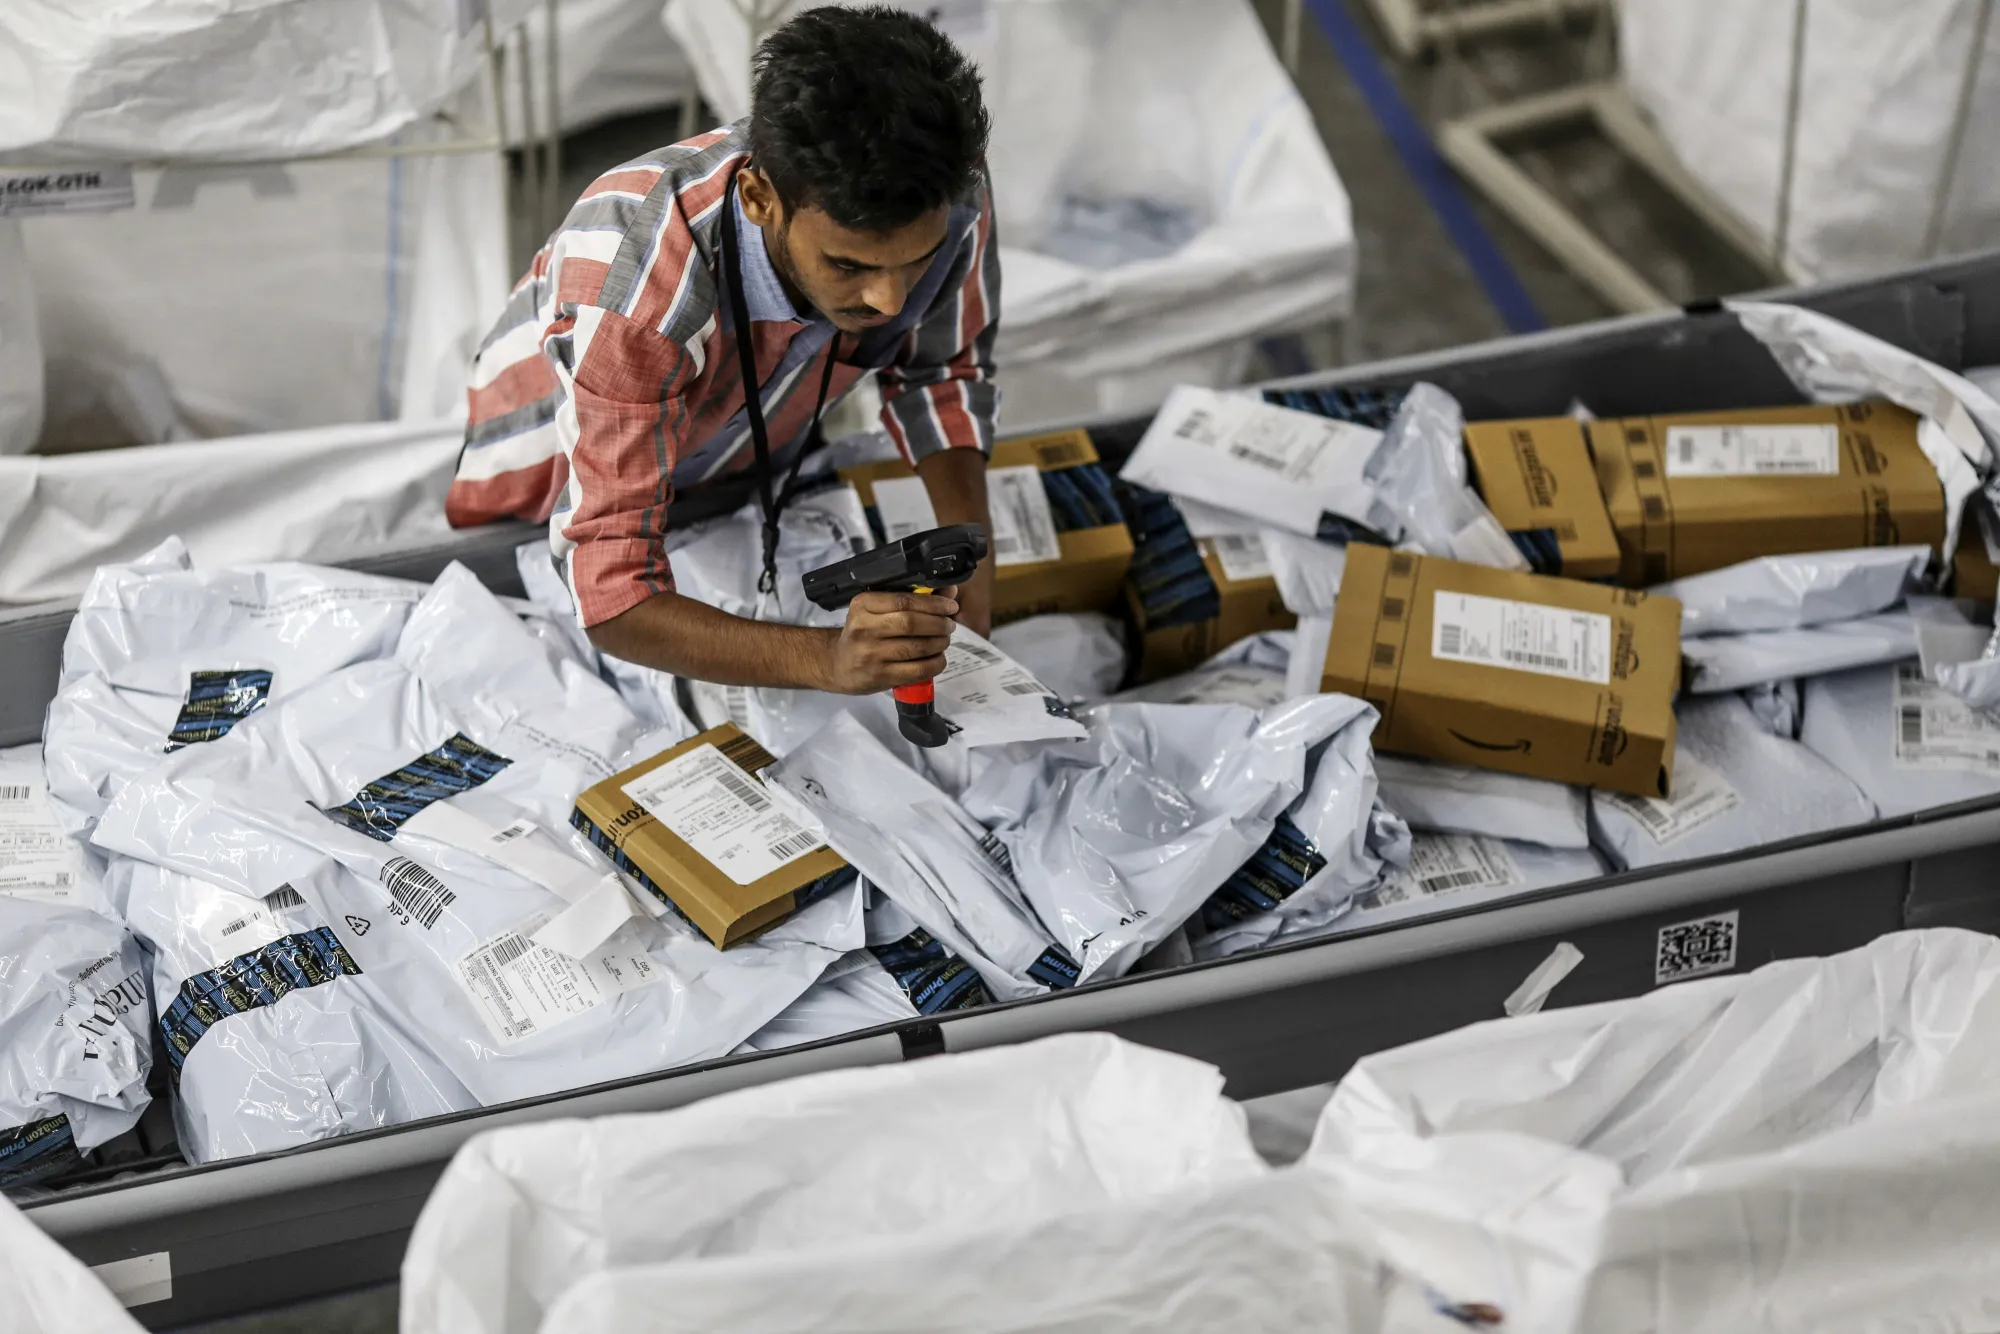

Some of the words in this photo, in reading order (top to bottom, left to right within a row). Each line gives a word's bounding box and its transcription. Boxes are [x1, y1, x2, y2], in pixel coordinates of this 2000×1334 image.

[387, 901, 403, 915] NP
[400, 916, 410, 926] 9
[481, 954, 498, 977] AMAZING
[494, 975, 513, 1001] DISCOUNTS
[639, 960, 649, 973] COD
[1042, 955, 1077, 978] Prime
[915, 977, 944, 1005] Prime
[26, 1115, 66, 1143] amazon
[0, 1138, 27, 1158] Prim
